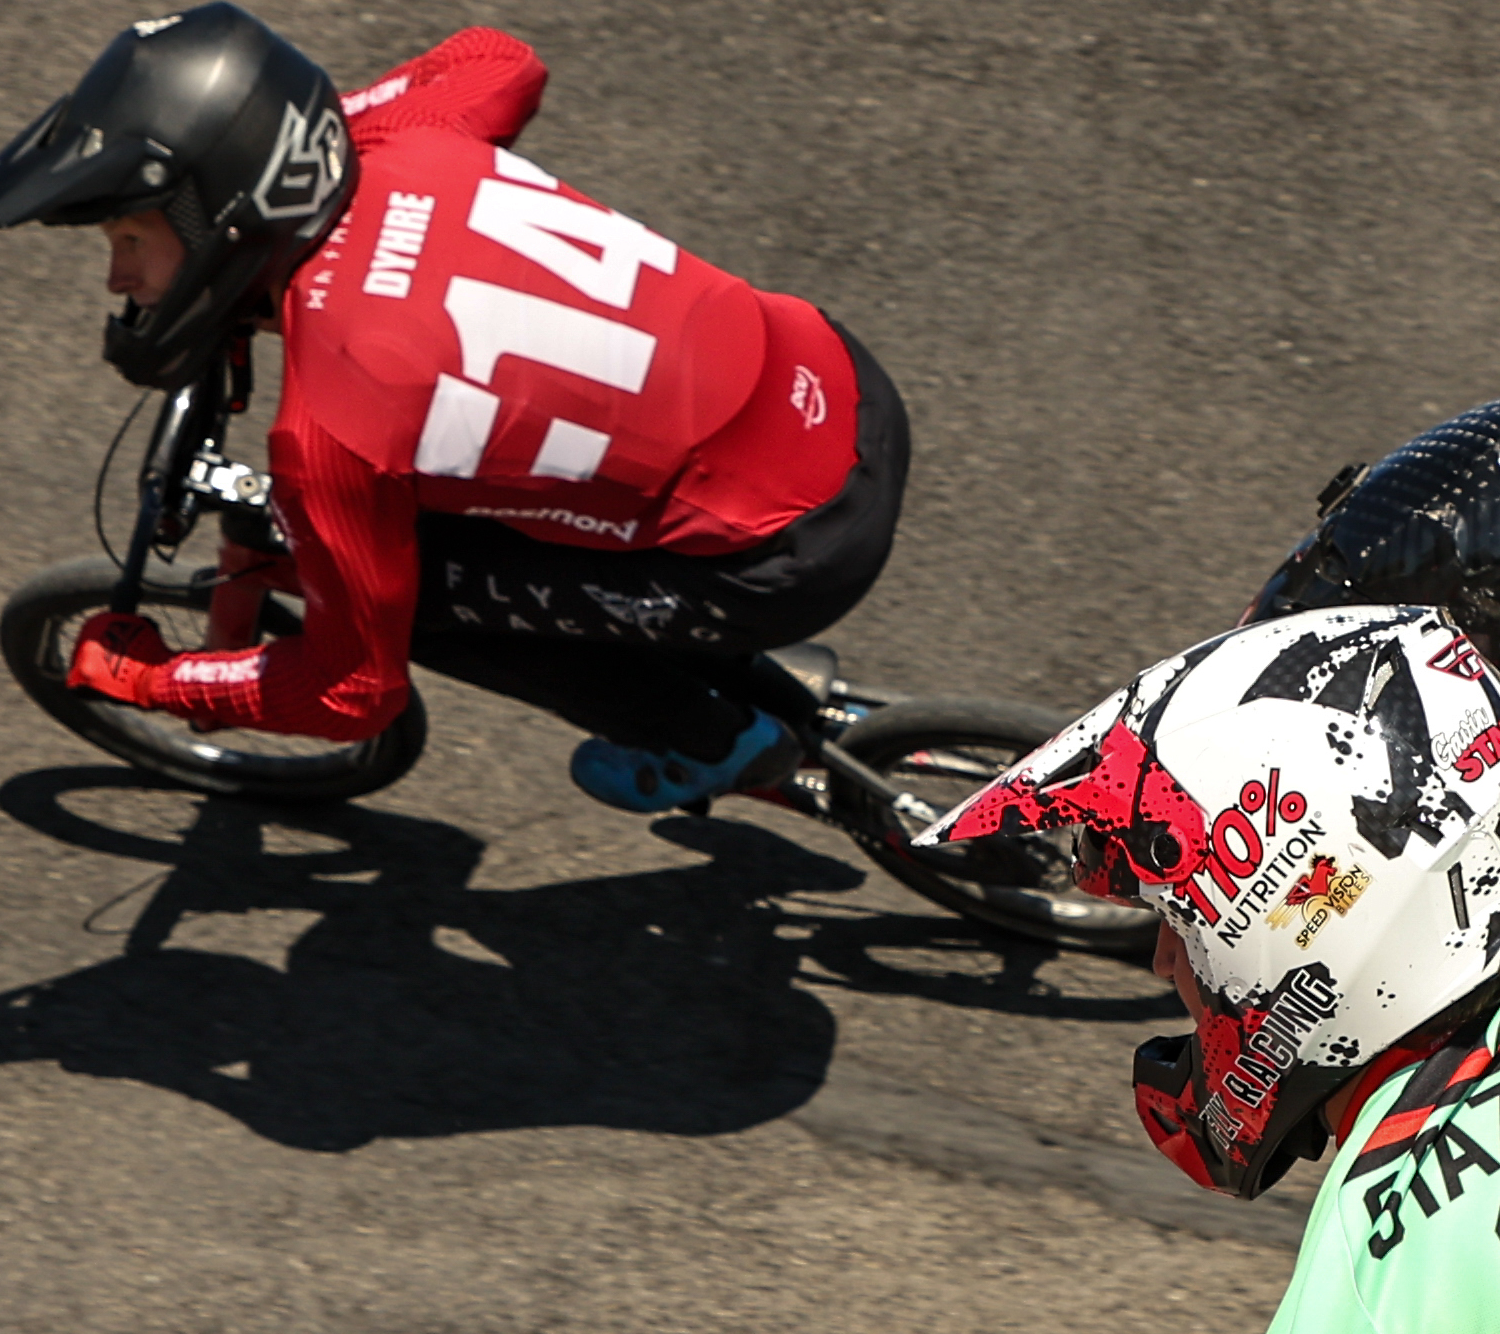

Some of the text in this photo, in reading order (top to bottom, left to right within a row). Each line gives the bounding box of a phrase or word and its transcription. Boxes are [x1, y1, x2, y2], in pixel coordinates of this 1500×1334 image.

[362, 190, 437, 300] DYHRE
[1431, 706, 1491, 771] Gavin
[1173, 766, 1309, 930] 110%
[1216, 817, 1328, 950] NUTRITION
[1334, 870, 1371, 916] BIKES
[1295, 863, 1364, 948] SPEED VISION
[1221, 968, 1341, 1108] RACING
